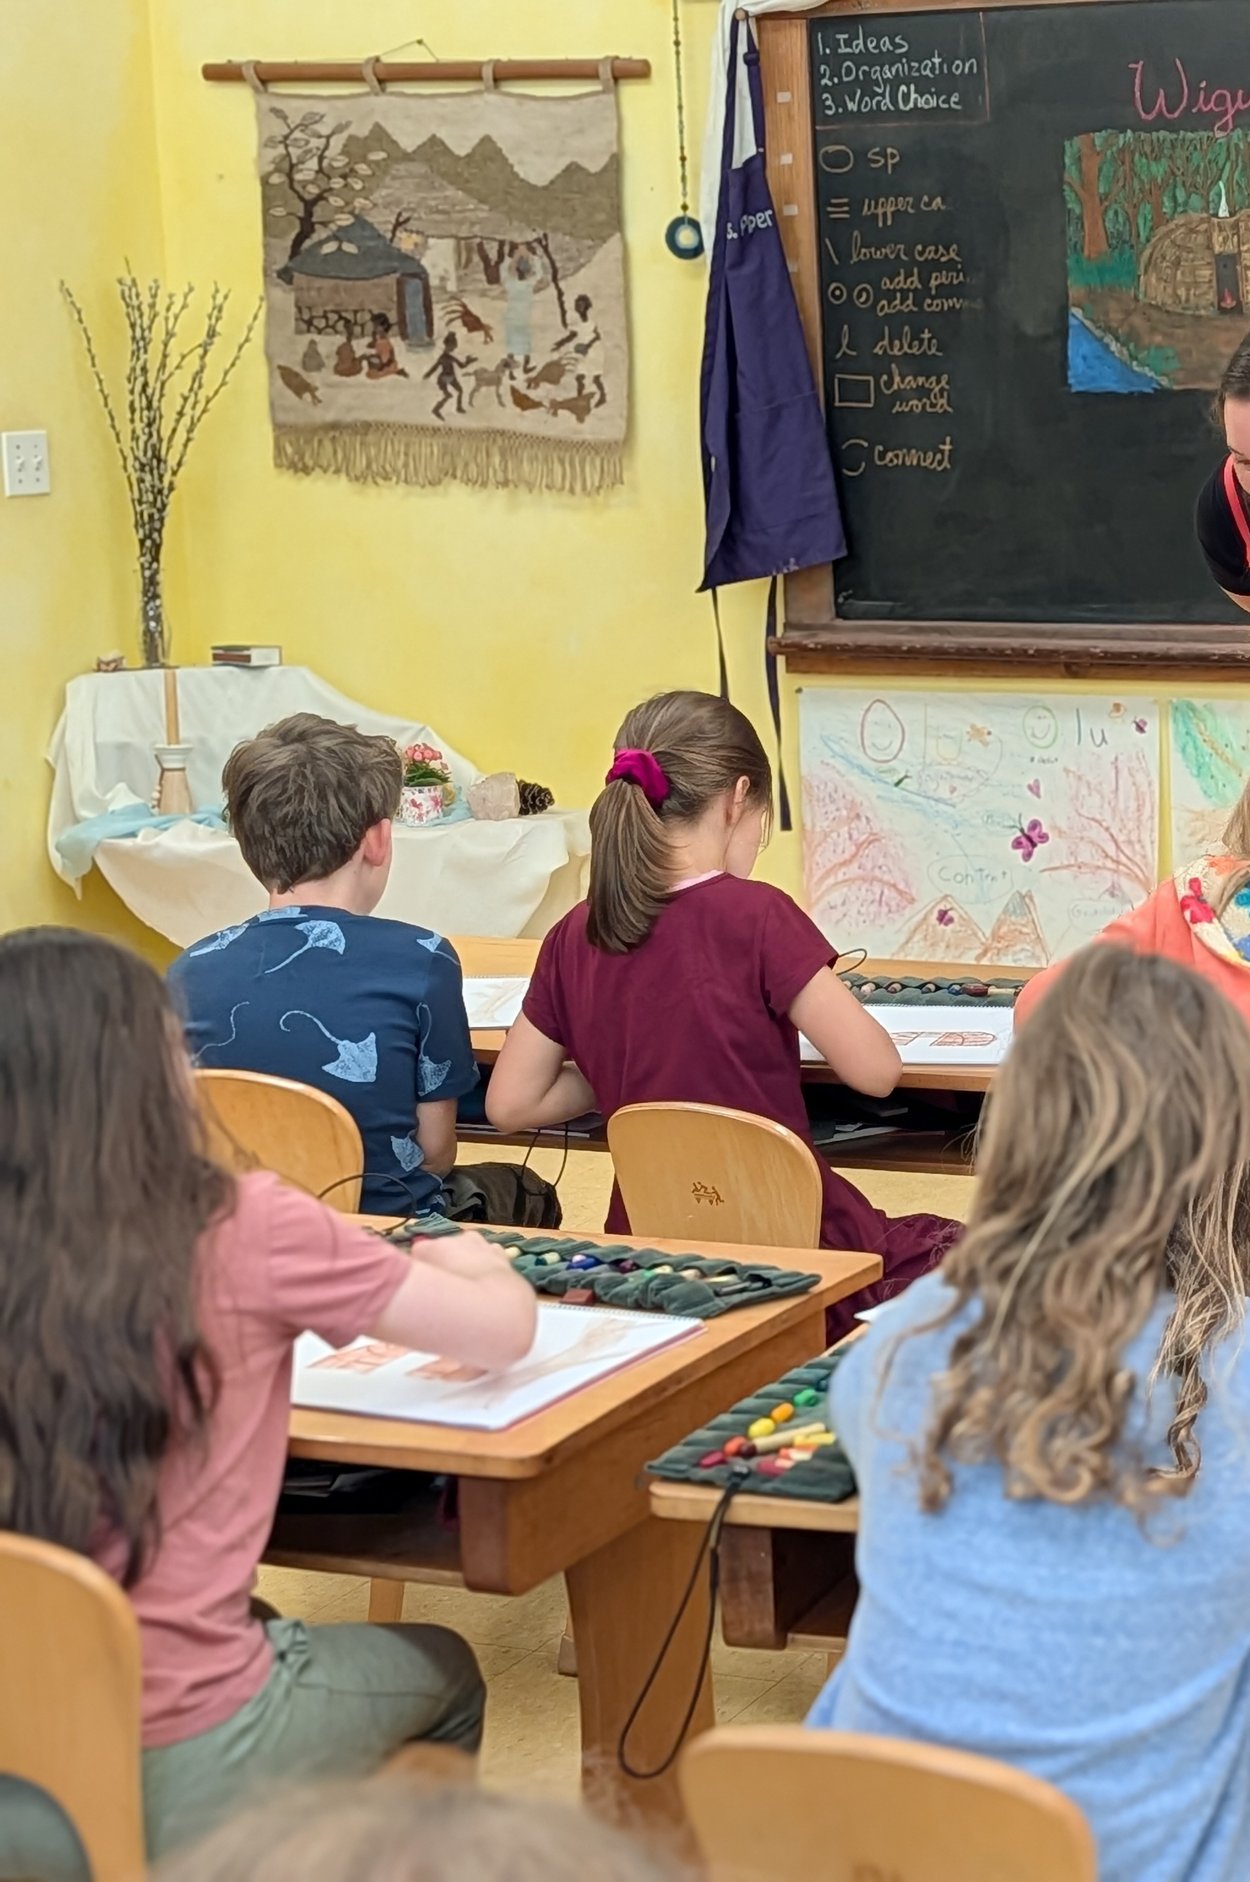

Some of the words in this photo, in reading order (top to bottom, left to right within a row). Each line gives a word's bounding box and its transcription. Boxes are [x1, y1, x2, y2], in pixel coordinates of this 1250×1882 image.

[898, 83, 962, 111] Choice
[862, 195, 915, 227] upper
[850, 231, 909, 264] lower
[914, 242, 962, 262] case
[881, 268, 922, 291] add
[877, 294, 918, 317] add
[873, 328, 943, 356] delete
[880, 364, 950, 402] change
[892, 396, 954, 413] word
